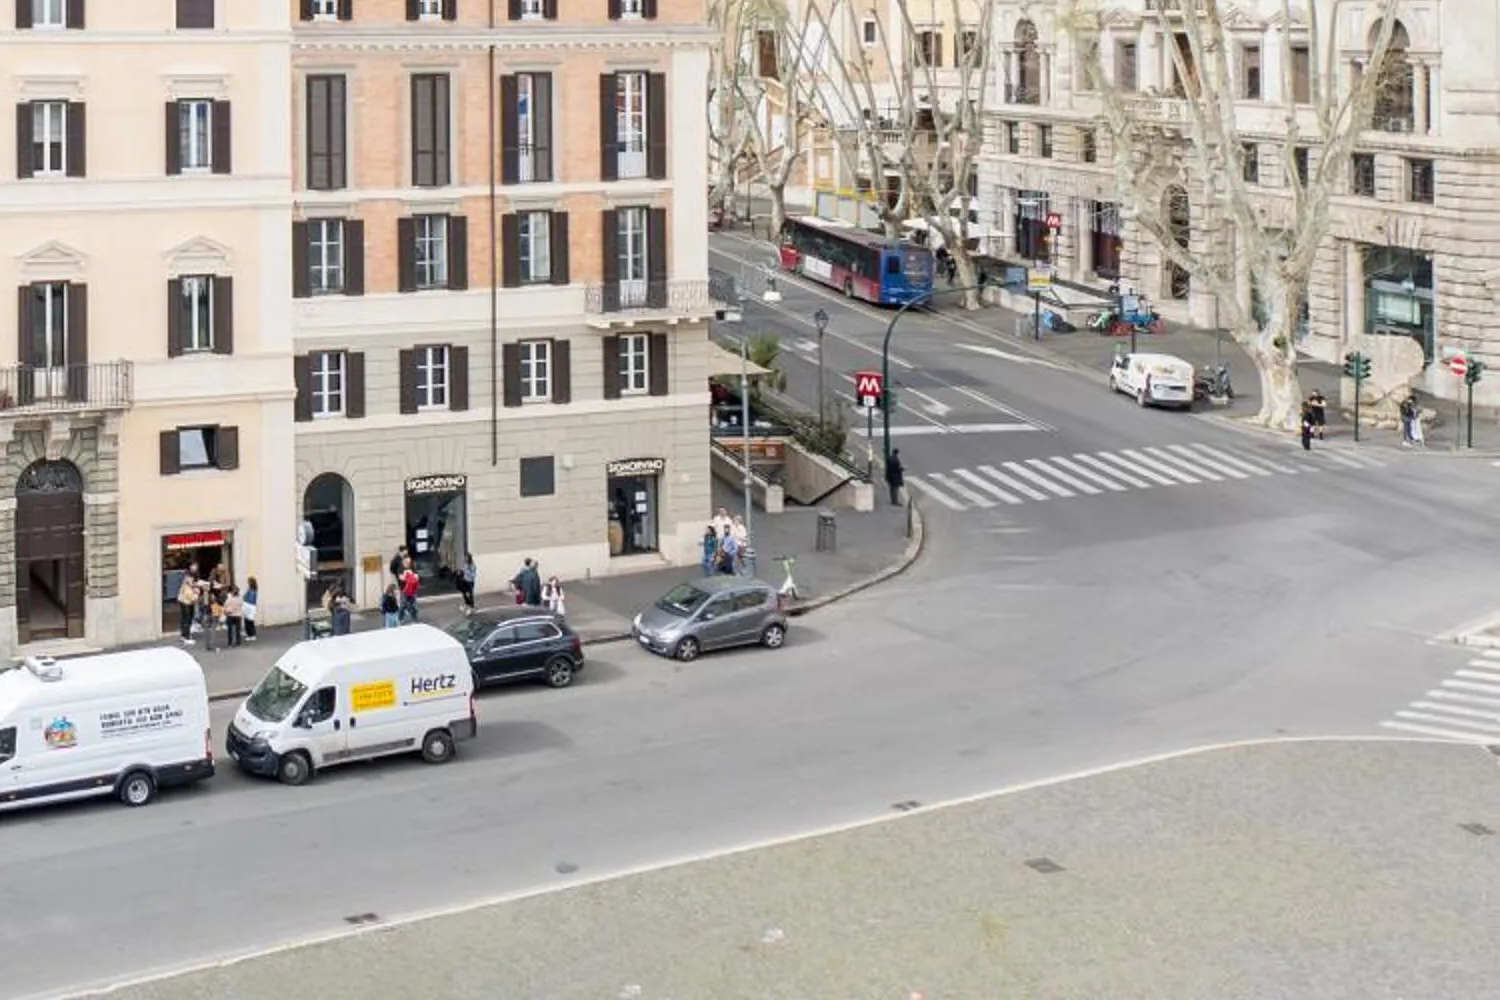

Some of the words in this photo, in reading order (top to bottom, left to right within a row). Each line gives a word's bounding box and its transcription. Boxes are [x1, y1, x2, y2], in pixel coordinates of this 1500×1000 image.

[859, 375, 880, 392] M
[607, 459, 663, 473] SIGNORVINO
[404, 475, 465, 491] SIGNORVINO
[411, 673, 456, 695] Hertz
